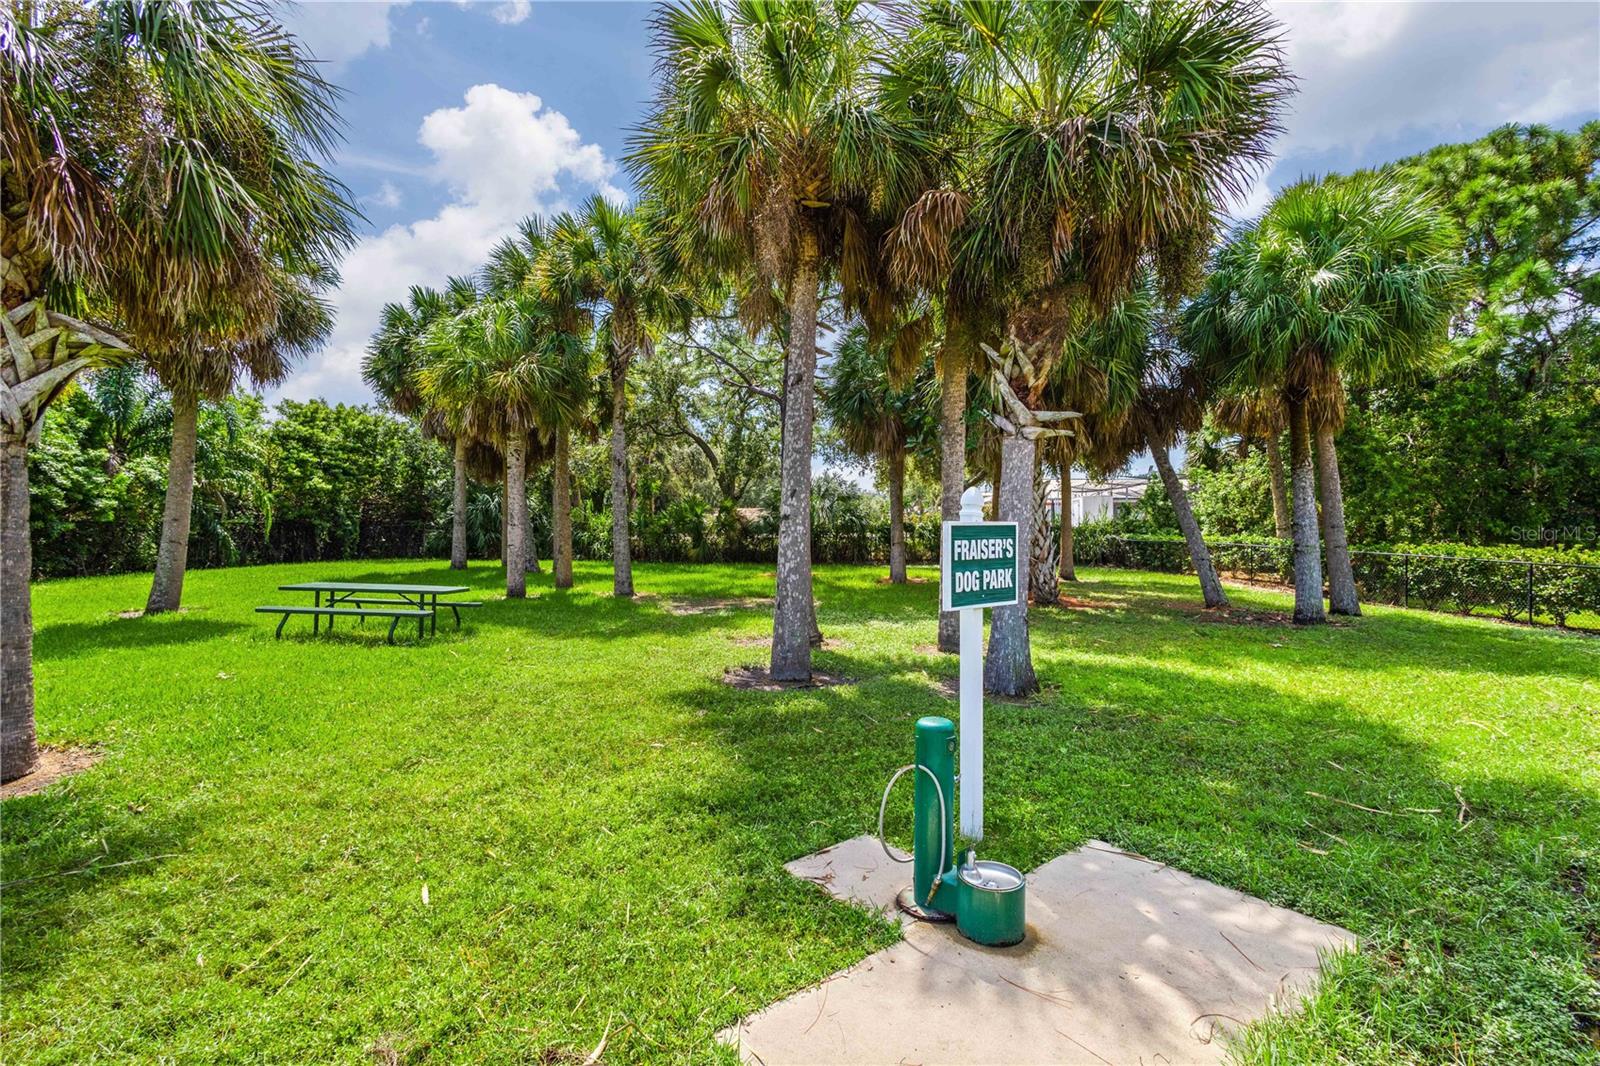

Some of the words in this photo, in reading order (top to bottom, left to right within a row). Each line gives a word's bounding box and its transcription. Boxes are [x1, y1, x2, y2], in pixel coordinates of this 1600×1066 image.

[954, 538, 1014, 561] FRAISER'S
[955, 570, 980, 593] DOG
[983, 568, 1013, 590] PARK
